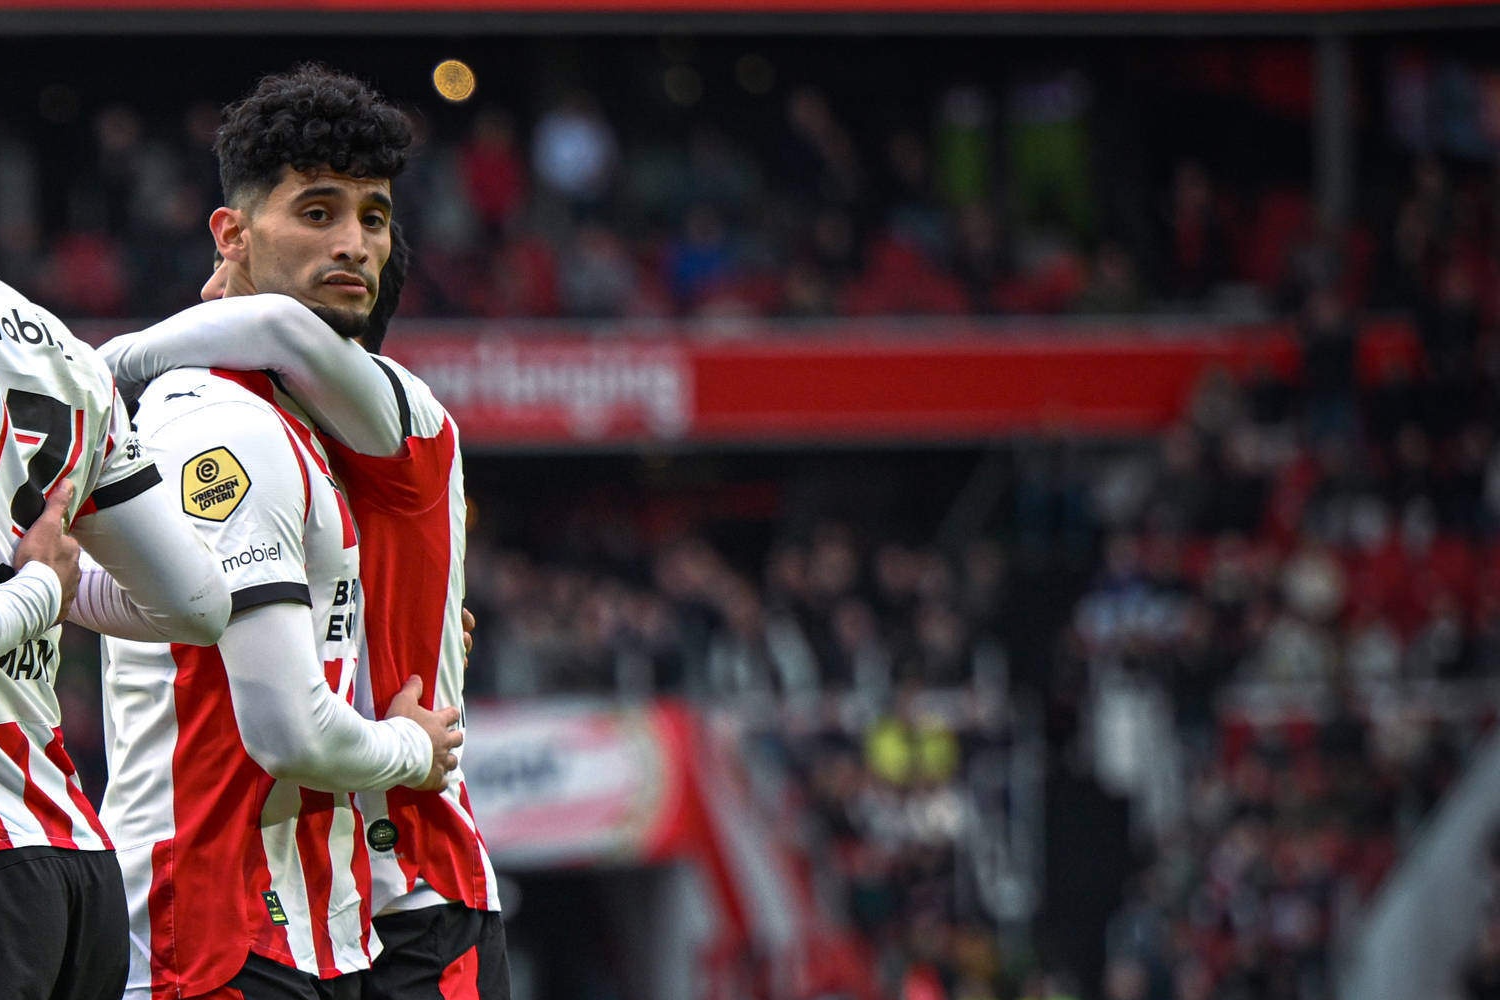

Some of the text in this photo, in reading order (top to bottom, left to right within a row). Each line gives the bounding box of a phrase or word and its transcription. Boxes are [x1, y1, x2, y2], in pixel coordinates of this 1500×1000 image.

[191, 479, 239, 504] VRIENDEN
[199, 489, 236, 511] LOTERIJ
[222, 542, 281, 573] mobiel
